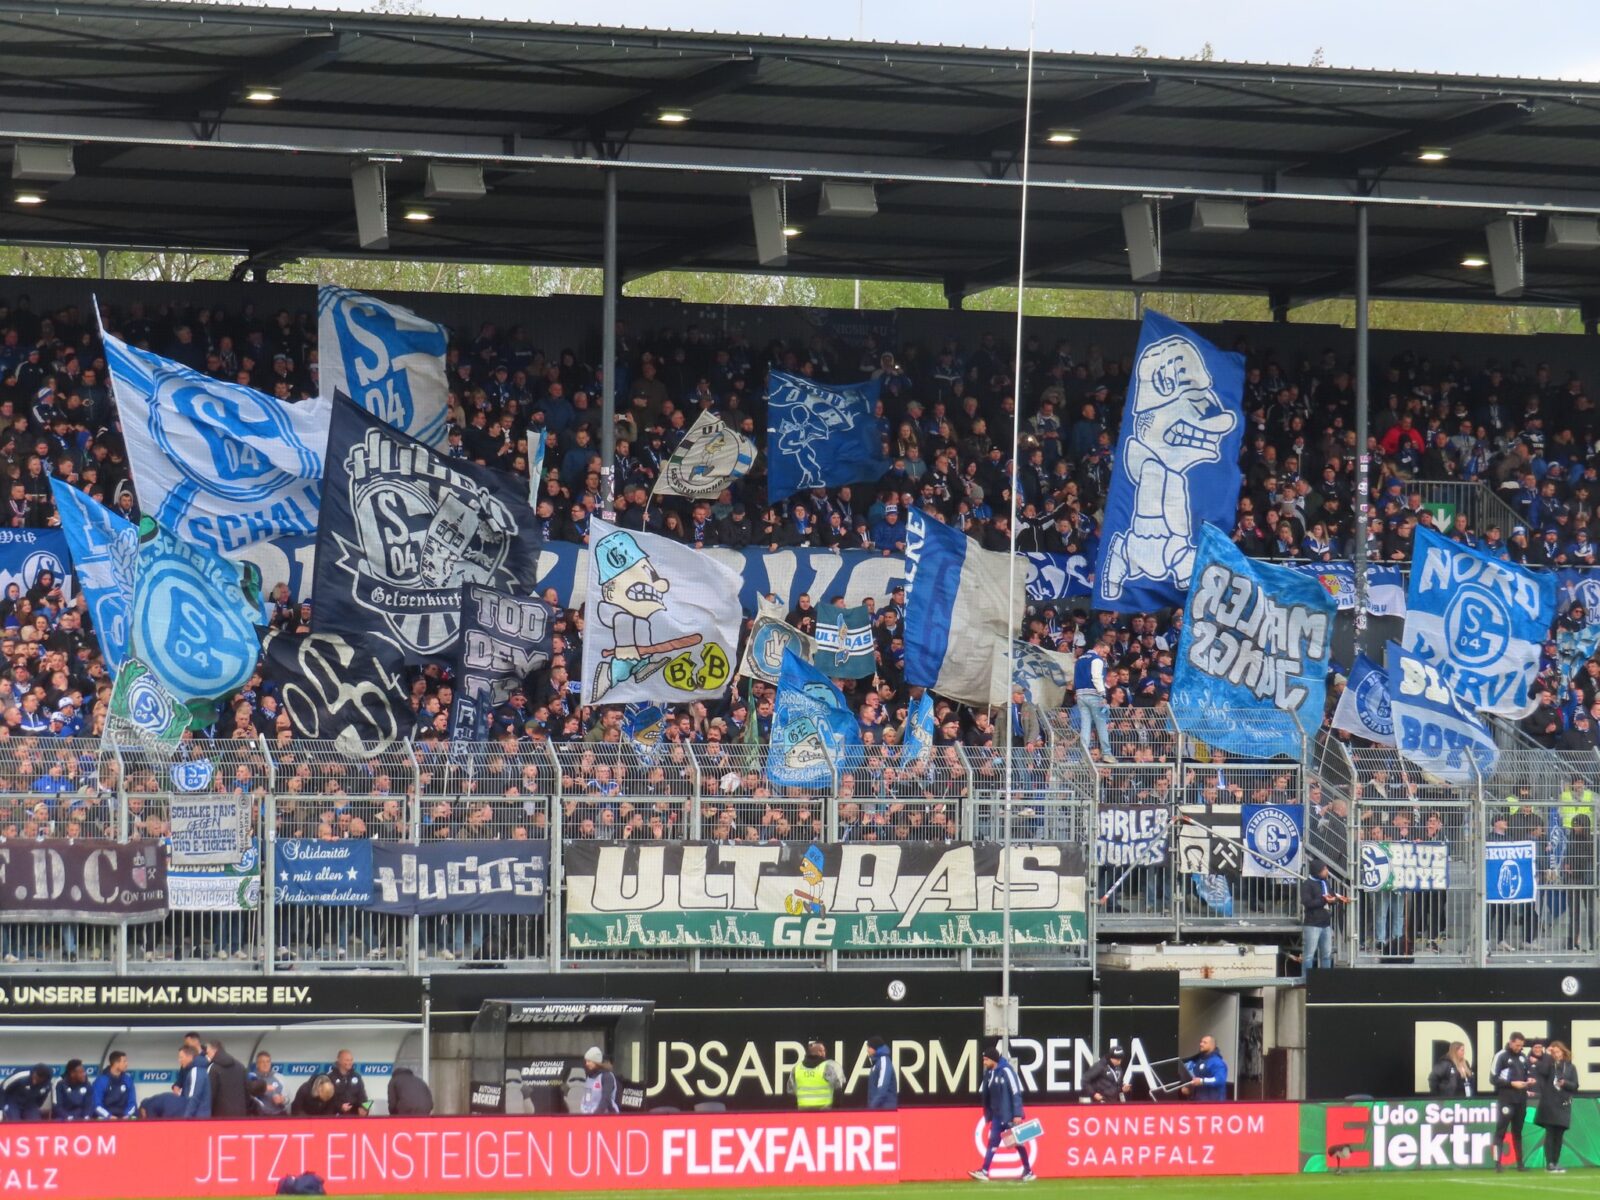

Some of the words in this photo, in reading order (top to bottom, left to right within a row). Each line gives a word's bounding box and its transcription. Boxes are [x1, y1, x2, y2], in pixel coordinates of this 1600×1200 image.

[1418, 547, 1540, 621] NORD
[371, 586, 462, 608] Gelsenkirch
[471, 588, 549, 644] TOD
[171, 805, 211, 818] SCHALKE
[172, 840, 191, 852] UND
[193, 840, 237, 852] E-TICKETS
[283, 839, 350, 860] Solidarität
[1391, 844, 1447, 867] BLUE
[293, 870, 313, 882] mit
[315, 866, 343, 881] allen
[374, 854, 544, 902] HUGOS
[1392, 868, 1447, 889] BOYZ
[590, 844, 1061, 927] ULTRAS
[14, 986, 96, 1004] UNSERE
[102, 986, 183, 1004] HEIMAT.
[187, 986, 270, 1004] UNSERE
[273, 985, 312, 1003] ELV.
[531, 1060, 565, 1068] AUTOHAUS
[1415, 1020, 1548, 1093] DIE
[144, 1072, 168, 1081] HYLO
[292, 1065, 318, 1073] HYLO
[364, 1065, 390, 1073] HYLO
[521, 1067, 564, 1076] DECKERT
[472, 1092, 501, 1106] DECKERT
[621, 1095, 643, 1108] ECKERT
[1373, 1105, 1418, 1125] Udo
[1425, 1103, 1497, 1124] Schmi
[1067, 1115, 1265, 1137] SONNENSTROM
[195, 1133, 313, 1184] JETZT
[327, 1131, 553, 1181] EINSTEIGEN
[568, 1129, 649, 1178] UND
[662, 1125, 899, 1175] FLEXFAHRE
[1067, 1146, 1215, 1166] SAARPFALZ
